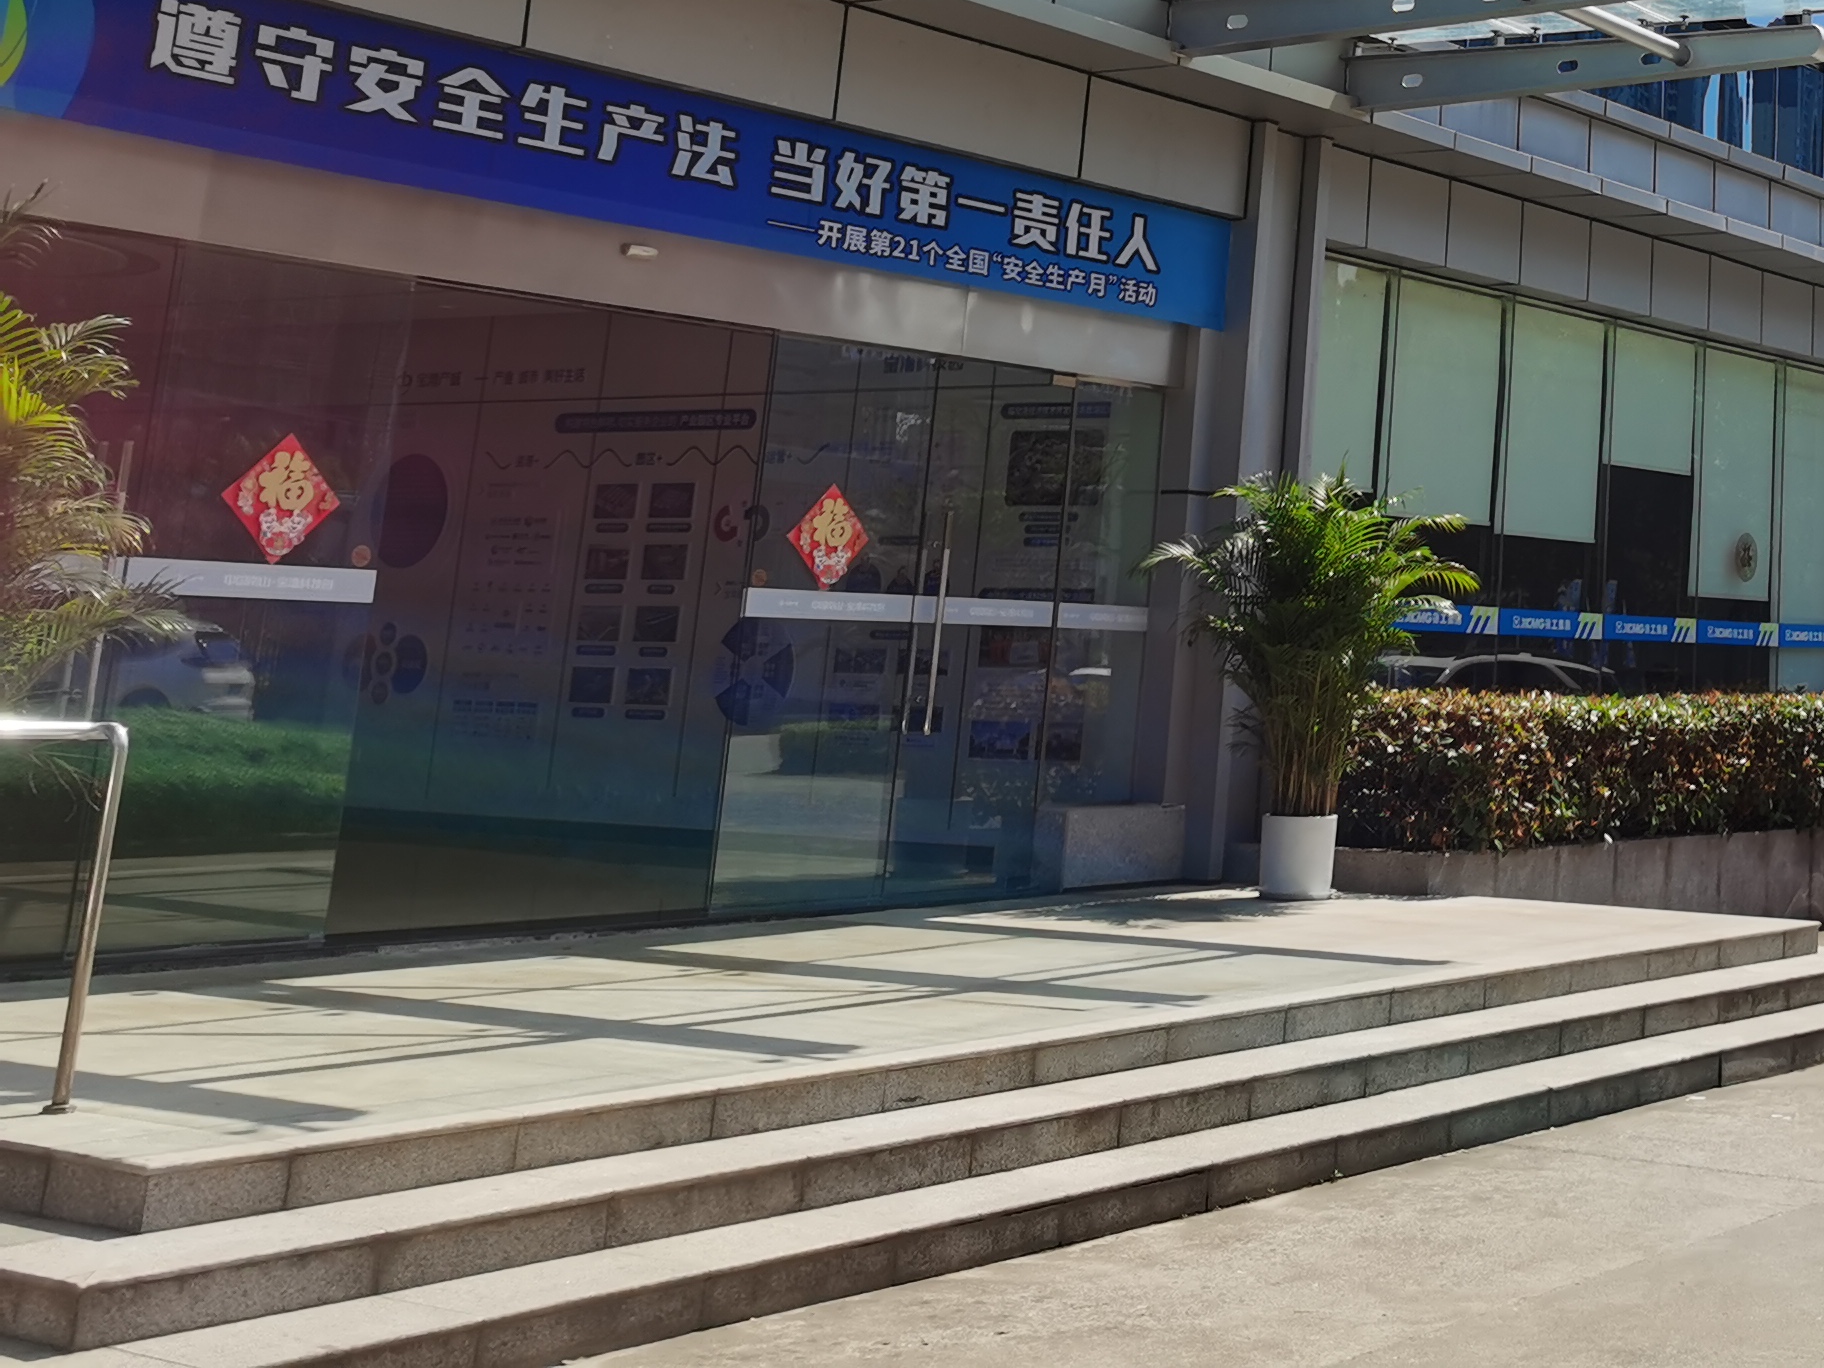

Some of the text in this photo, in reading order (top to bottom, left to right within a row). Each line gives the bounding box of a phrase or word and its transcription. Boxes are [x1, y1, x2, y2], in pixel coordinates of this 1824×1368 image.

[769, 137, 1161, 273] 当好第一责任人
[258, 449, 314, 512] 福
[812, 498, 852, 551] 福
